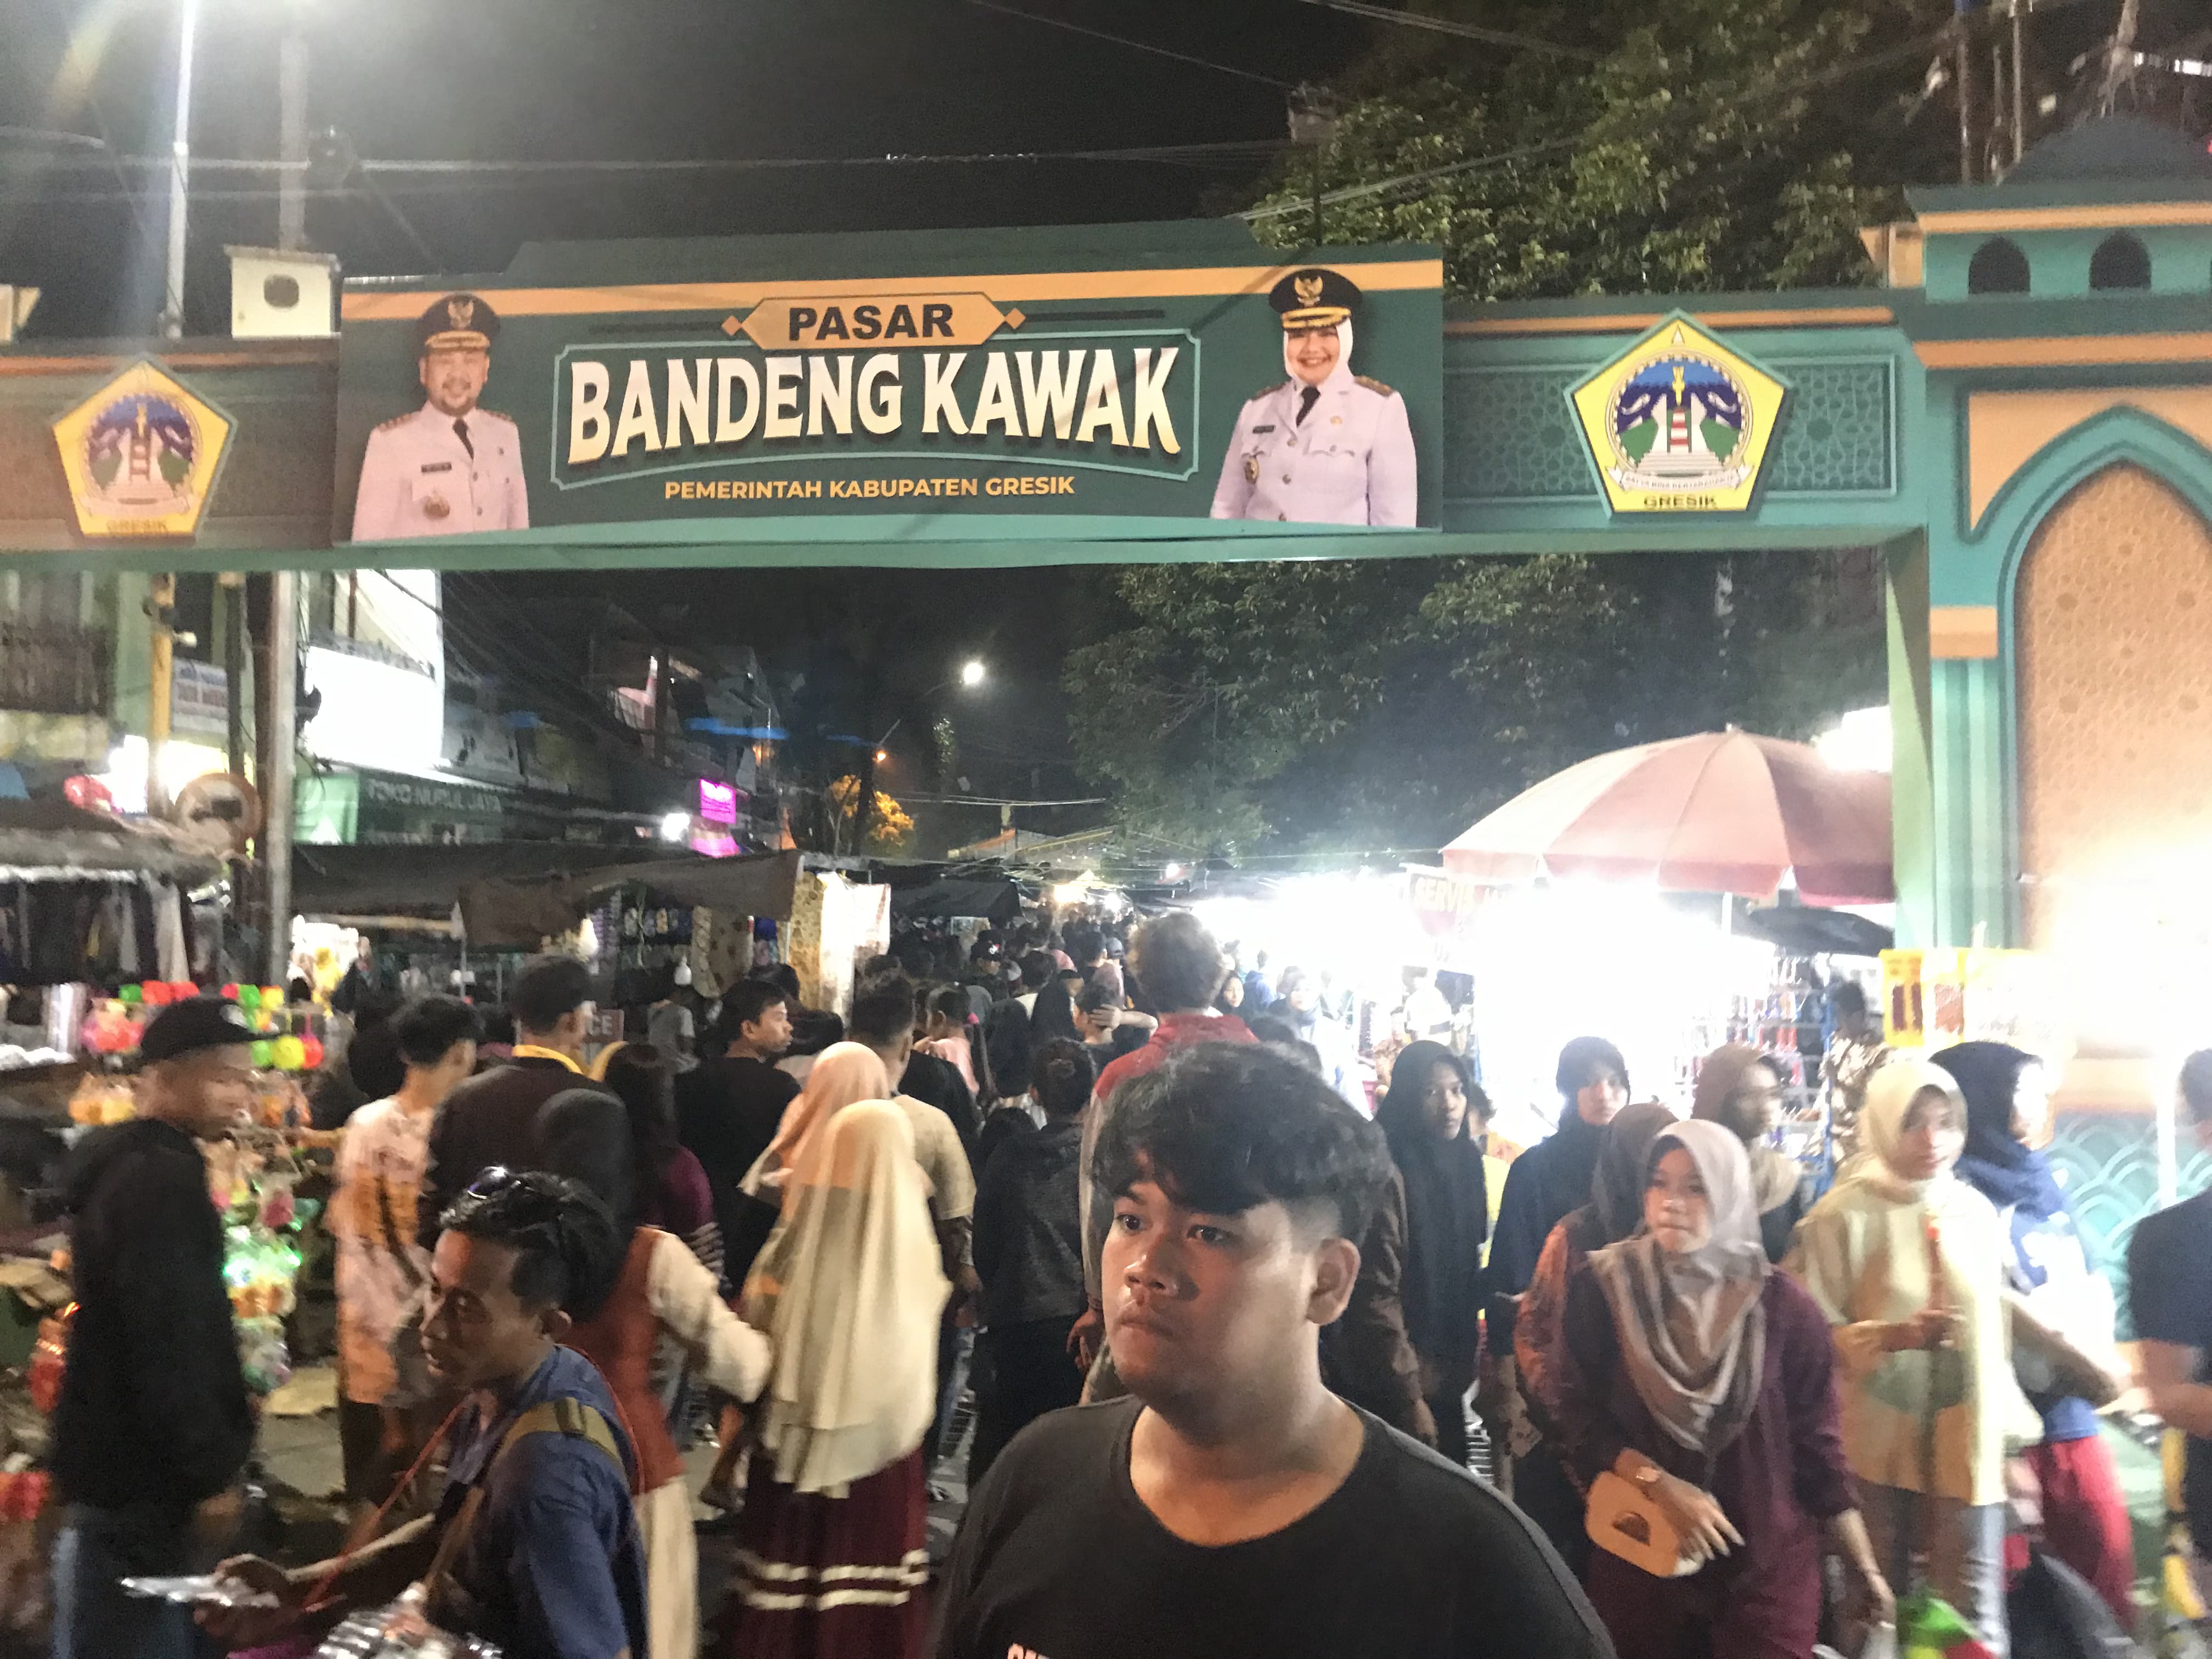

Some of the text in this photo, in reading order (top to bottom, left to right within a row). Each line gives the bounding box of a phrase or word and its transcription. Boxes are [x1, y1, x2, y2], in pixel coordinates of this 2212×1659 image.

[789, 303, 955, 341] PASAR
[568, 347, 1181, 464] BANDENG KAWAK
[665, 476, 1075, 499] PEMERINTAH KABUPATEN GRESIK
[1644, 494, 1717, 508] GRESIK
